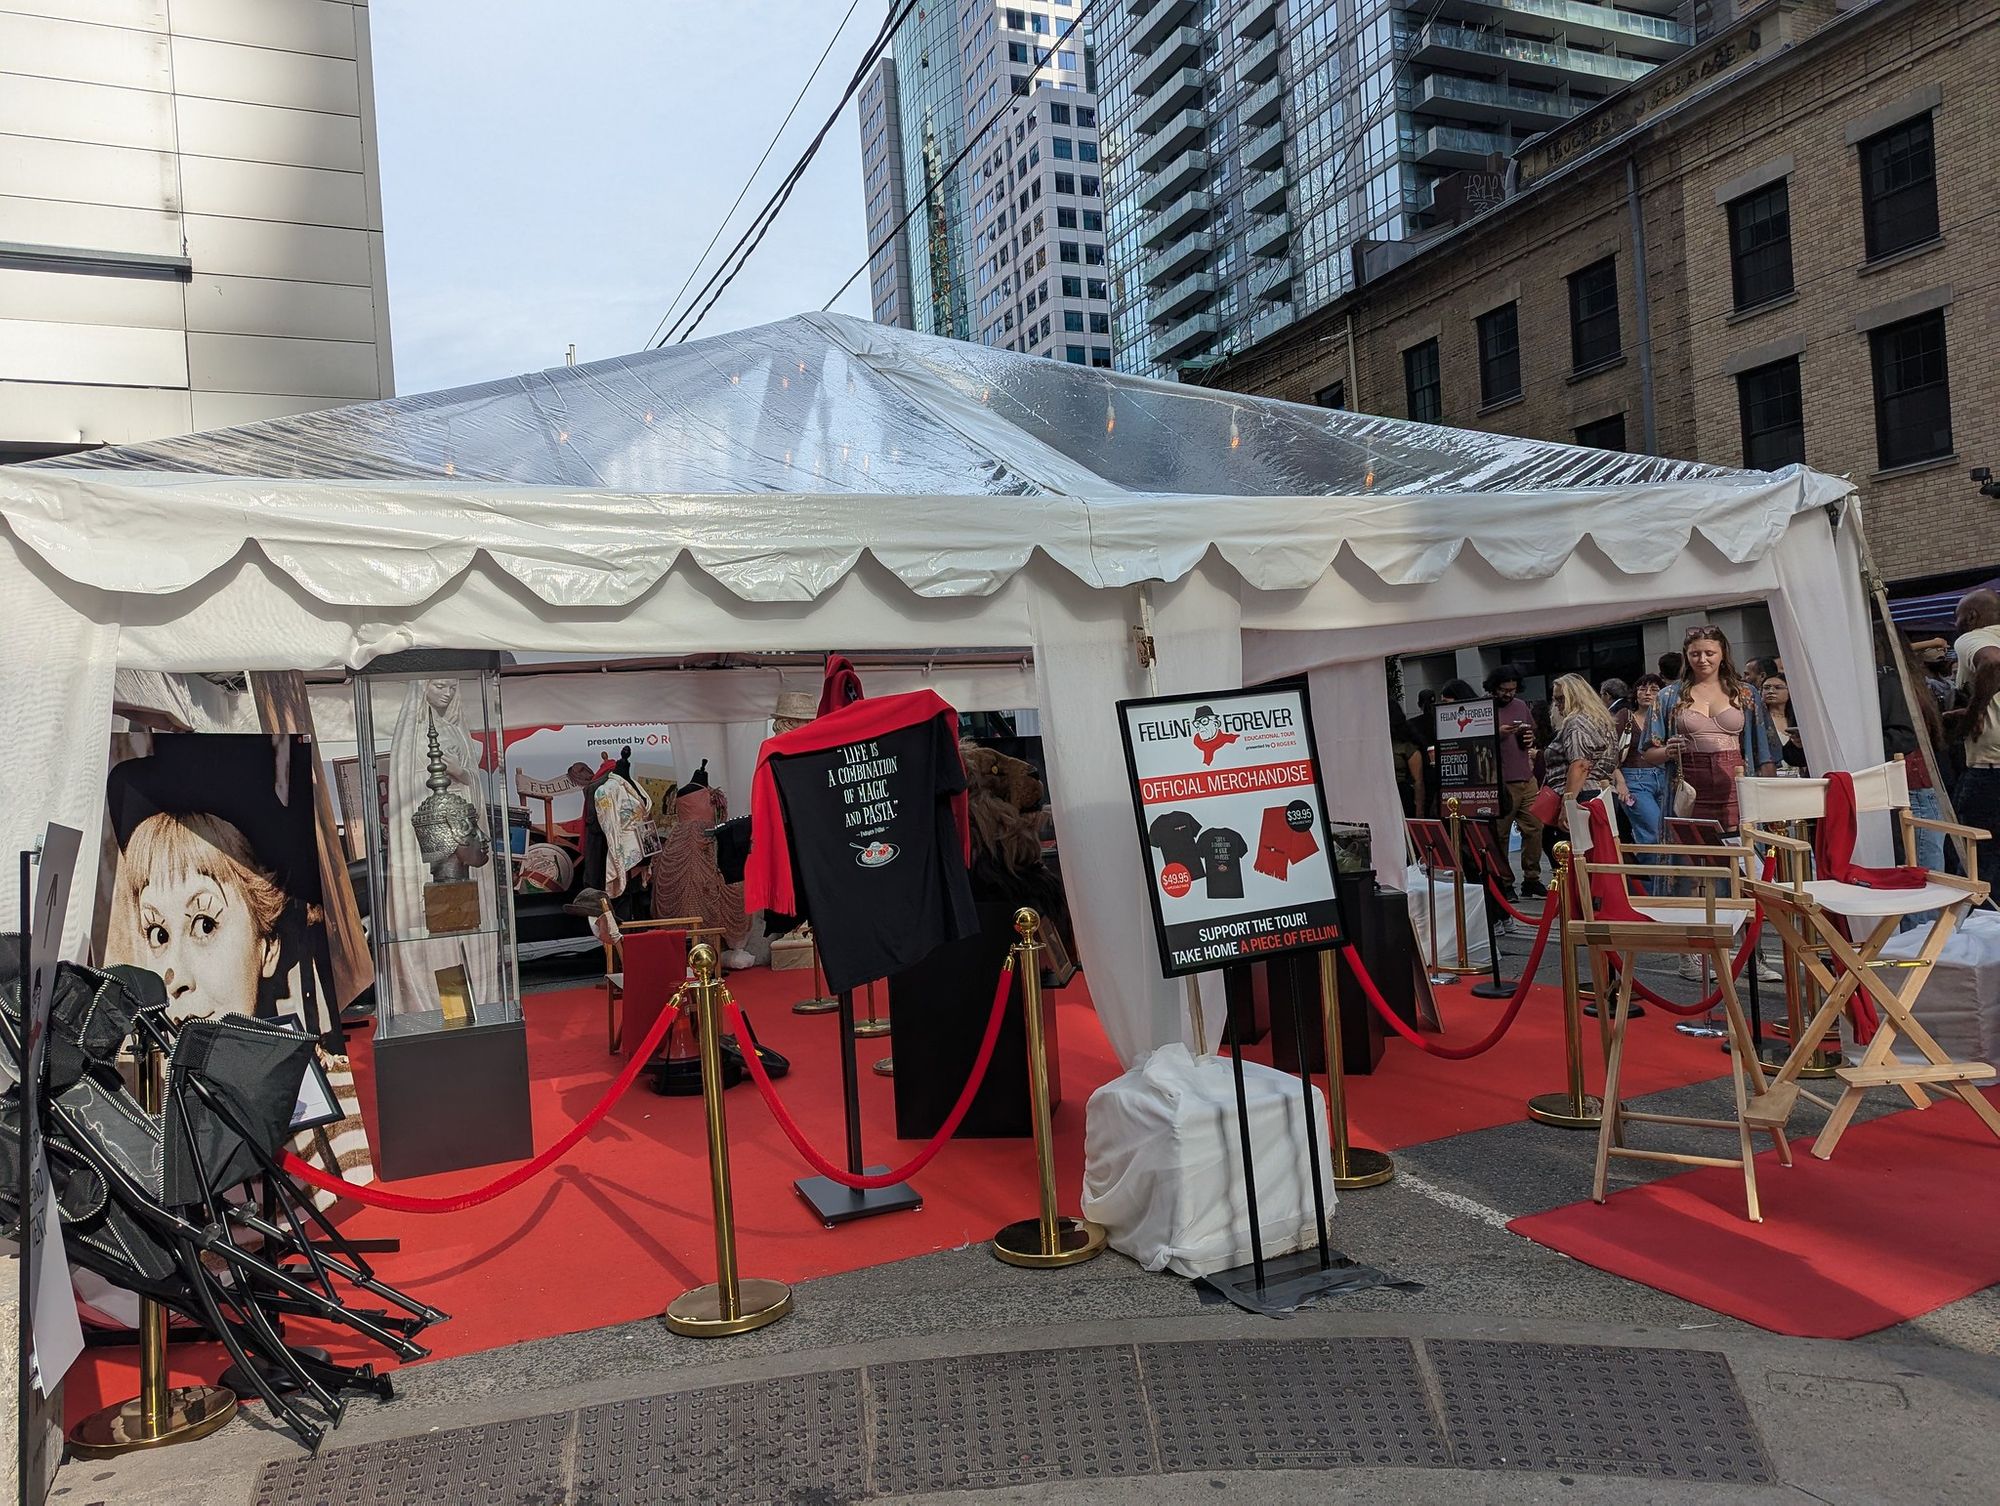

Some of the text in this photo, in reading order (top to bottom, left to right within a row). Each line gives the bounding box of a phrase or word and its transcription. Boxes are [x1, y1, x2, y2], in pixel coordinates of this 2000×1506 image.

[1223, 708, 1293, 732] FOREVER
[587, 736, 633, 747] presented
[634, 736, 645, 745] by
[1244, 733, 1280, 742] EDUCATIONAL
[870, 742, 879, 757] IS
[1441, 753, 1468, 764] FEDERICO
[828, 756, 898, 788] A COMBINATION
[1441, 764, 1468, 777] FELLINI
[539, 778, 577, 794] FELLIN
[1143, 764, 1309, 800] OFFICIAL MERCHANDISE
[843, 779, 890, 805] OF MAGIC
[1462, 791, 1476, 799] TOUR
[845, 811, 862, 828] AND
[1287, 808, 1312, 822] $39.95
[1162, 873, 1189, 886] $49.95
[1199, 912, 1308, 942] SUPPORT THE TOUR!
[1172, 925, 1339, 965] TAKE HOME A PIECE OF FELLINI
